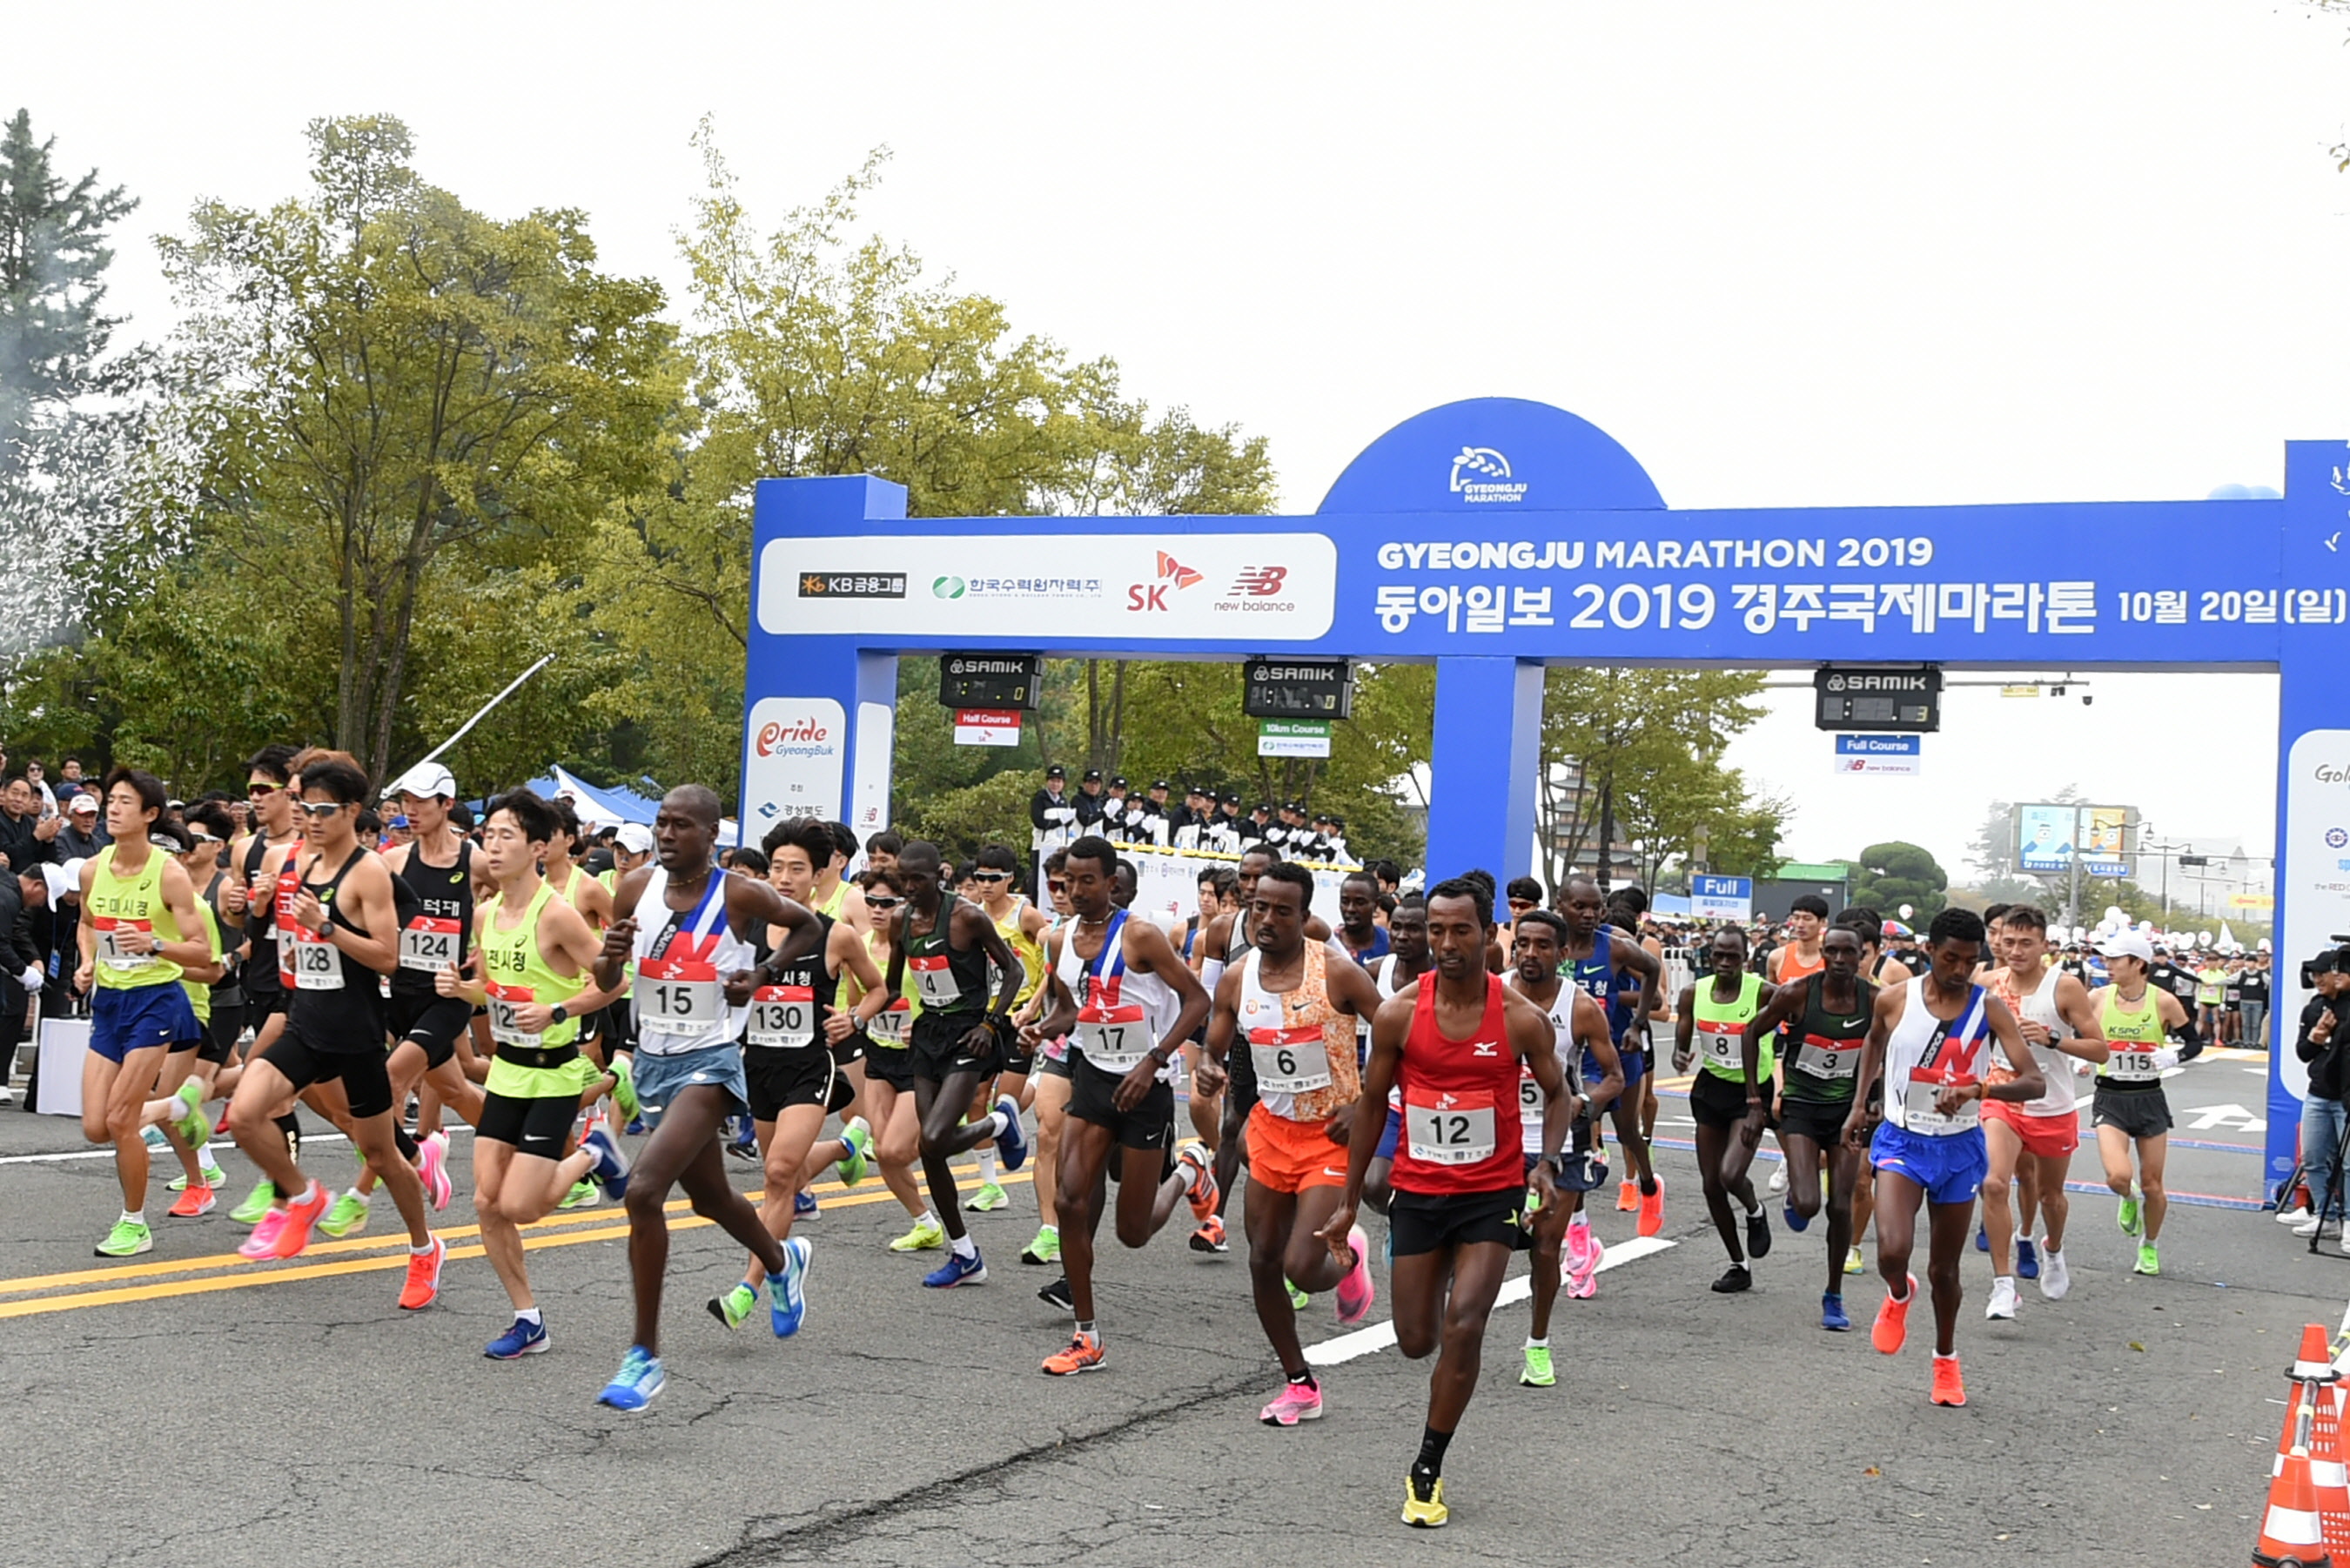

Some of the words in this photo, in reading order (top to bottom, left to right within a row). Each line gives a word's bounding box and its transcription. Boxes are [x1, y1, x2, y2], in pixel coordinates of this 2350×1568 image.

[1464, 483, 1528, 493] GYEONGJU
[1464, 493, 1521, 503] MARATHON
[1377, 540, 1584, 570] GYEONGJU
[1595, 538, 1825, 569] MARATHON
[1836, 537, 1933, 567] 2019
[1126, 584, 1169, 611] SK
[1214, 602, 1239, 611] new
[1243, 600, 1295, 611] balance
[1374, 584, 1554, 633] 동아일보
[1570, 582, 1715, 629] 2019
[1731, 580, 2097, 634] 경주국제마라톤
[2118, 590, 2187, 624] 10월
[965, 660, 1023, 673] SAMIK
[1271, 667, 1334, 680] SAMIK
[1847, 676, 1926, 690] SAMIK
[963, 714, 980, 723] Half
[981, 714, 1010, 724] Course
[1266, 724, 1290, 733] 10km
[1292, 725, 1325, 734] Course
[776, 745, 836, 758] GyeongBuk
[1847, 740, 1867, 750] Full
[1869, 740, 1909, 751] Course
[784, 805, 824, 816] 경상북도
[1704, 879, 1737, 895] Full
[421, 899, 460, 917] 덕대
[410, 934, 449, 957] 124
[651, 923, 677, 962] alance
[298, 946, 330, 972] 128
[781, 970, 811, 987] 시청
[925, 974, 937, 994] 4
[655, 985, 693, 1015] 15
[493, 1002, 515, 1028] 12
[755, 1006, 802, 1030] 130
[1098, 1027, 1125, 1050] 17
[1716, 1037, 1729, 1055] 8
[1919, 1031, 1945, 1069] balance
[1277, 1049, 1297, 1075] 6
[1823, 1053, 1838, 1069] 3
[2115, 1054, 2151, 1070] 115
[1436, 1101, 1448, 1110] SK
[1430, 1116, 1470, 1144] 12
